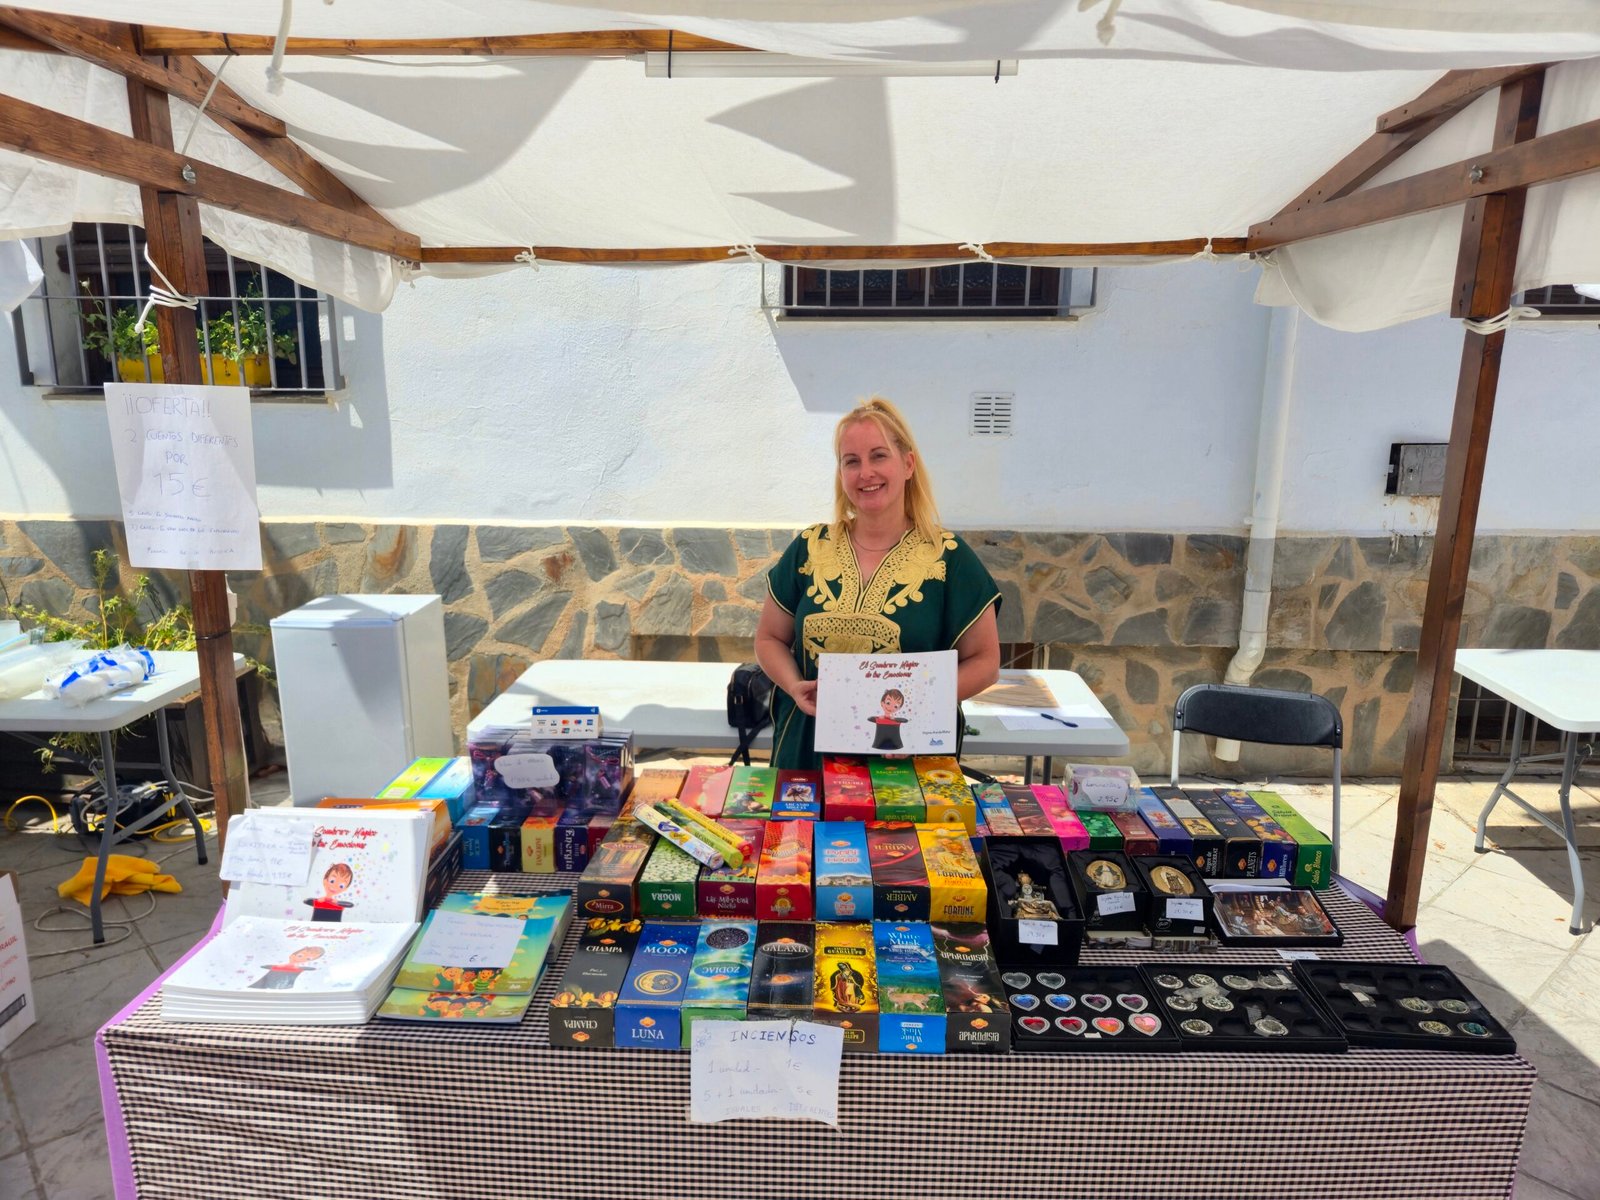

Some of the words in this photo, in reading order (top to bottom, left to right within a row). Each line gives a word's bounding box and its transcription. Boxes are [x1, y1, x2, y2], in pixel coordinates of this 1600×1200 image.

[124, 428, 138, 443] 2
[145, 428, 184, 442] CUENTOS
[191, 432, 240, 448] DIFERENTES
[165, 451, 189, 466] POR
[651, 892, 682, 901] MOGRA
[886, 893, 918, 901] AMBER
[596, 902, 615, 910] Mirra
[943, 905, 974, 916] FORTUNE
[586, 945, 623, 954] CHAMPA
[643, 945, 689, 955] MOON
[762, 944, 809, 954] GALAXIA
[702, 966, 740, 974] ZODIAC
[563, 1019, 598, 1029] CHAMPA
[631, 1028, 665, 1040] LUNA
[730, 1029, 817, 1045] INCIENSOS
